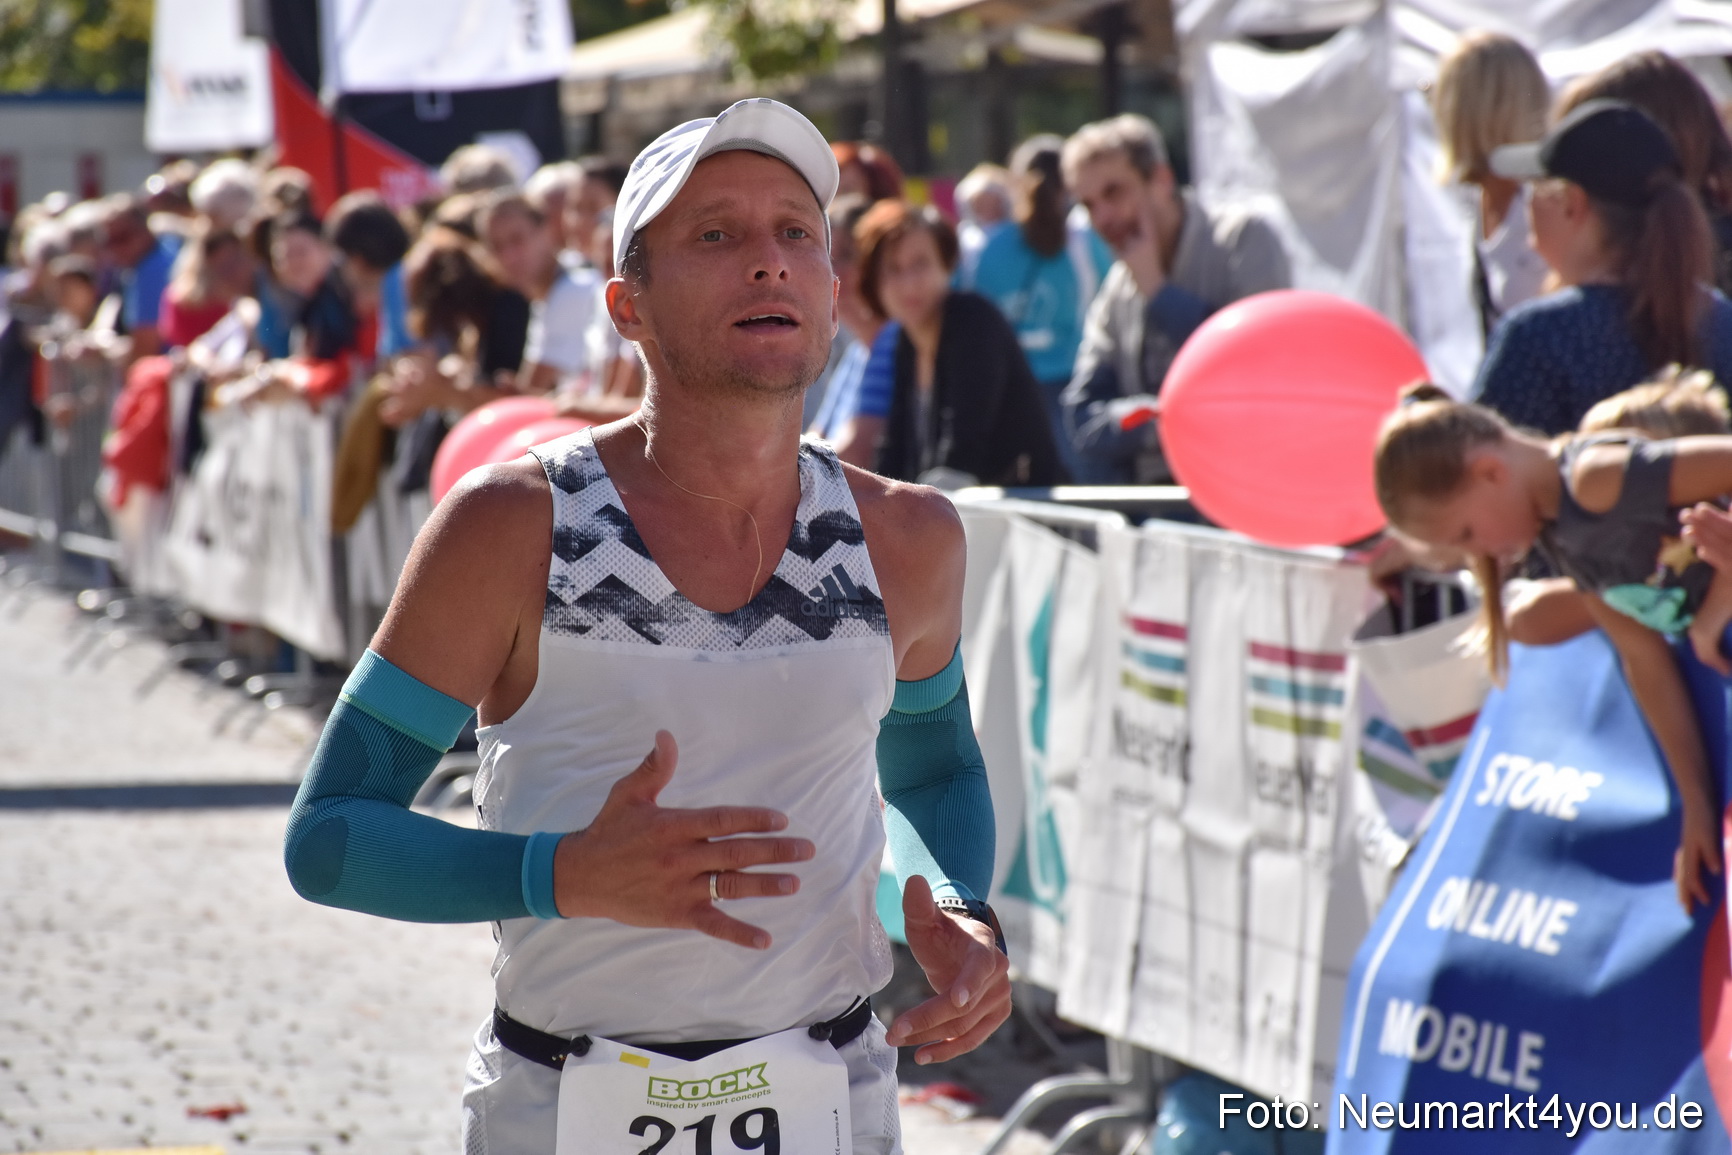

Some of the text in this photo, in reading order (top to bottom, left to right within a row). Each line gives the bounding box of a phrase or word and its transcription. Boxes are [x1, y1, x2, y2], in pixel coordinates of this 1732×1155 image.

[800, 596, 875, 621] adidas
[1475, 752, 1605, 821] STORE
[1426, 875, 1578, 956] ONLINE
[1378, 997, 1544, 1092] MOBILE
[646, 1098, 685, 1110] inspired
[701, 1098, 729, 1108] smart
[730, 1089, 772, 1104] concepts
[648, 1062, 770, 1101] BOCK
[628, 1107, 781, 1155] 219
